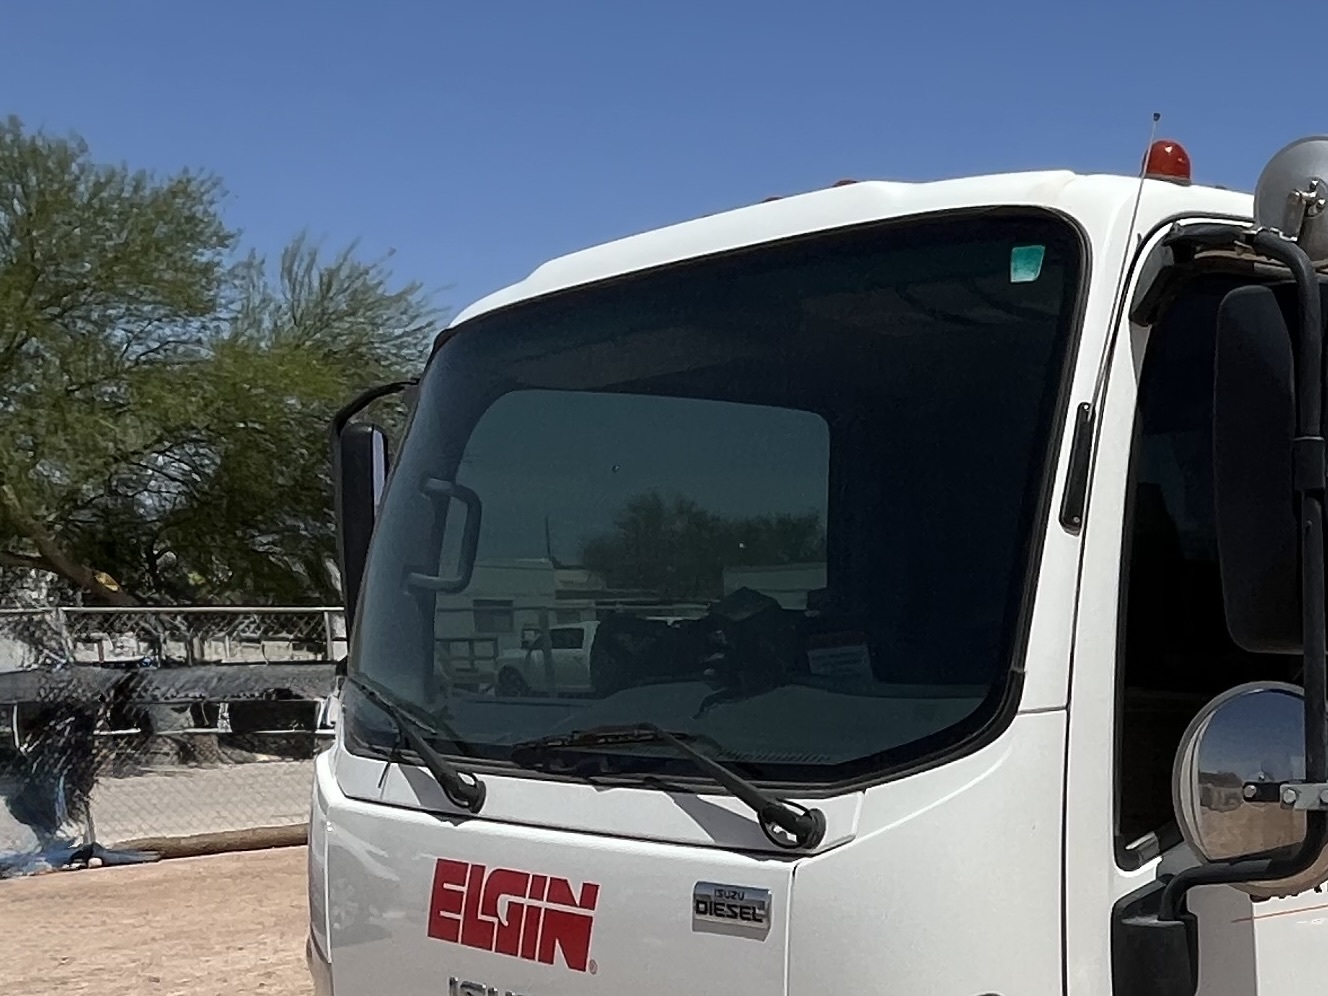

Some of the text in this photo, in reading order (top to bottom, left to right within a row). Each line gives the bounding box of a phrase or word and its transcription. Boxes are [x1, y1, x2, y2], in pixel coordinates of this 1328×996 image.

[714, 888, 745, 901] ISUZU
[428, 858, 600, 972] ELGIN
[695, 899, 764, 923] DIESEL
